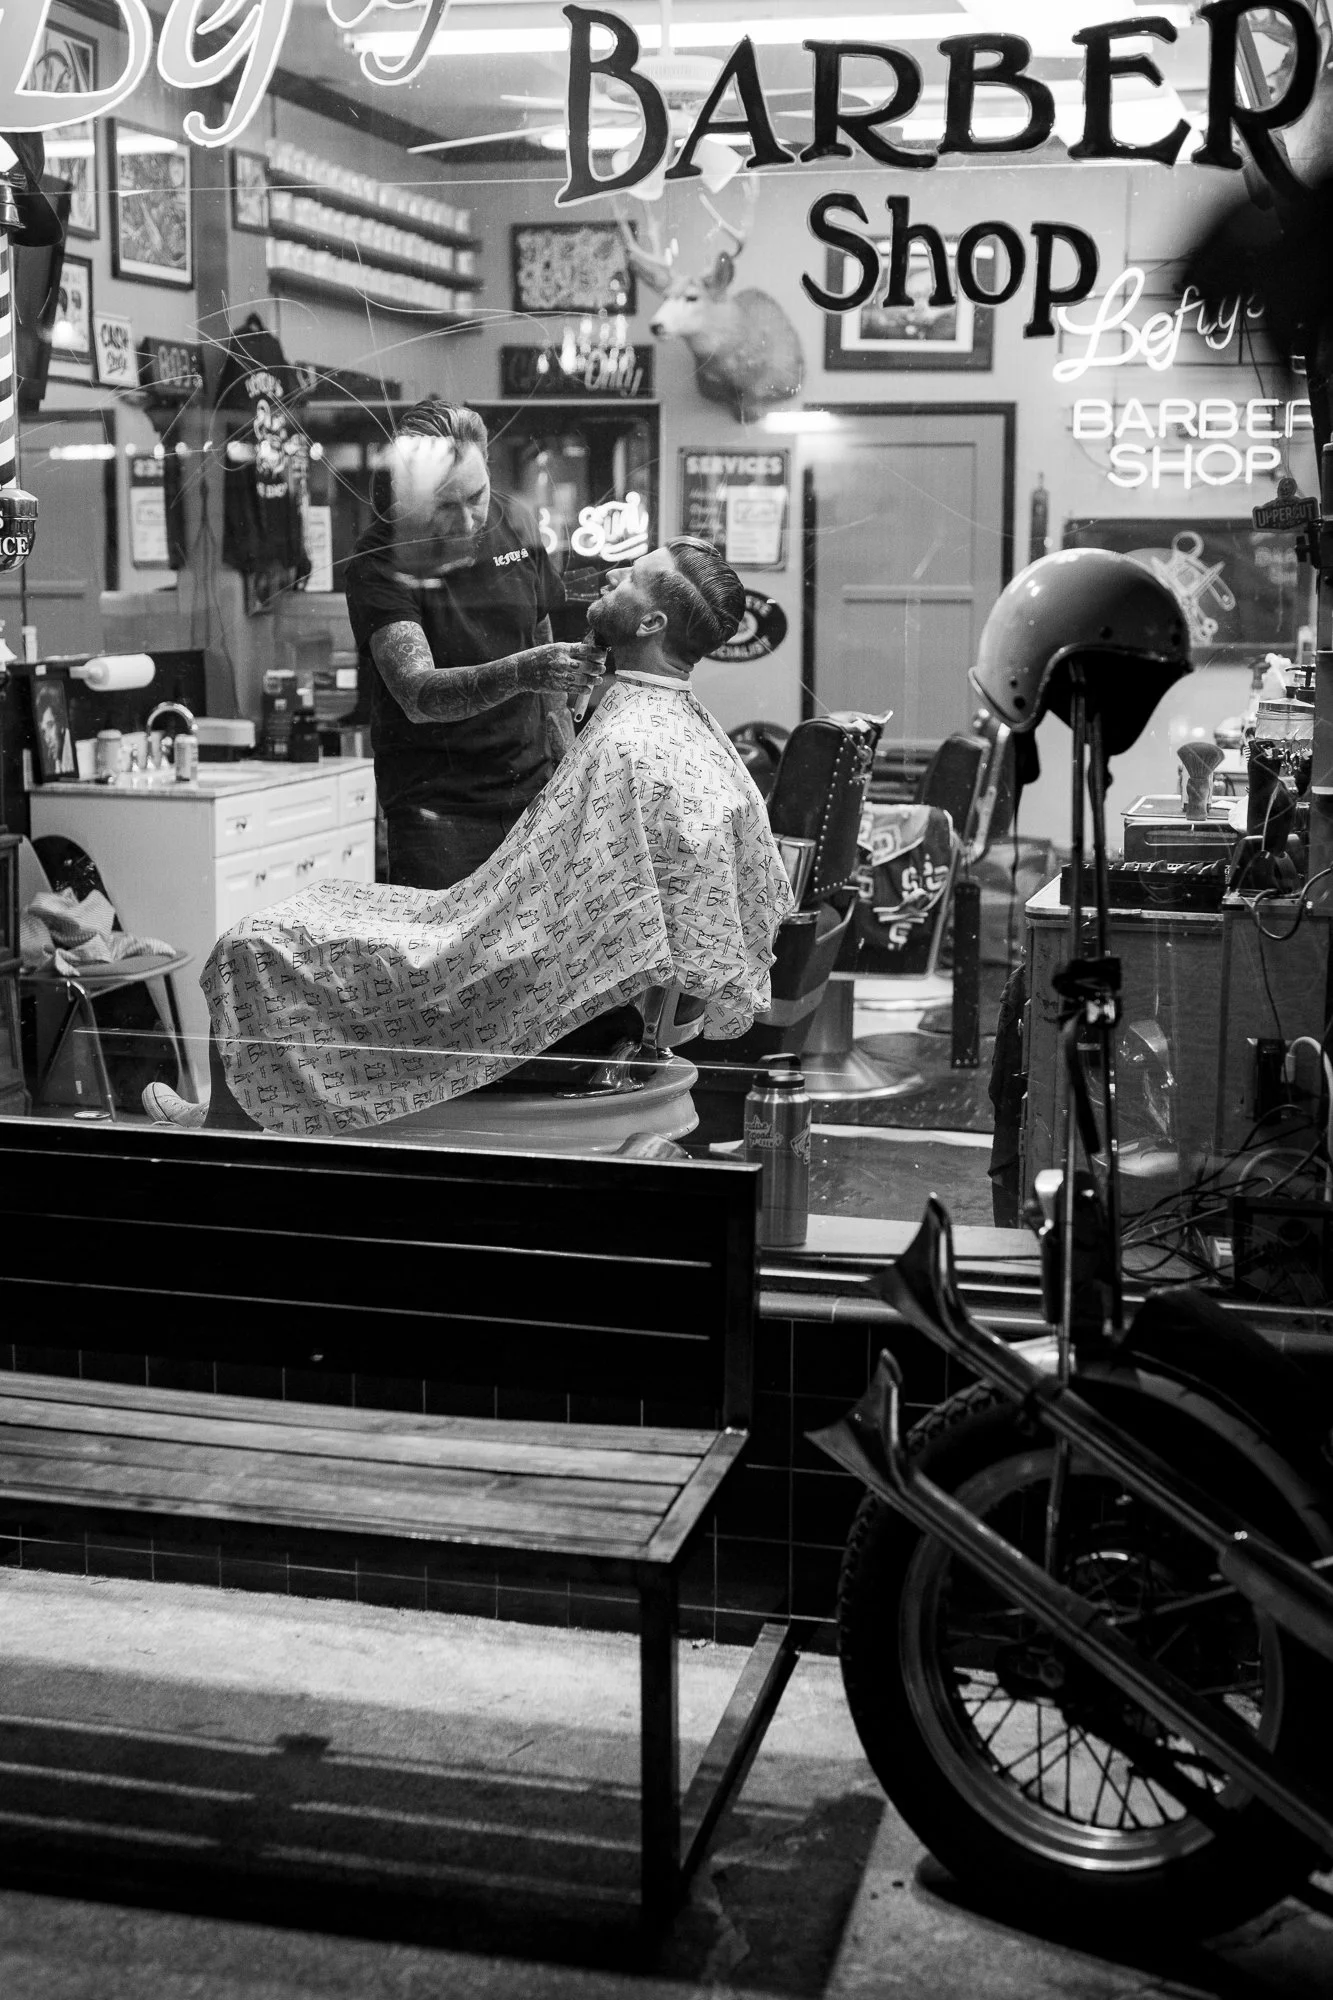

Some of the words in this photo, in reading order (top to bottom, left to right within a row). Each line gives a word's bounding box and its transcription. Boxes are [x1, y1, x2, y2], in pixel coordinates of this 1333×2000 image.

[555, 1, 1324, 207] BARBER
[801, 189, 1099, 339] Shop
[1107, 443, 1282, 489] SHOP
